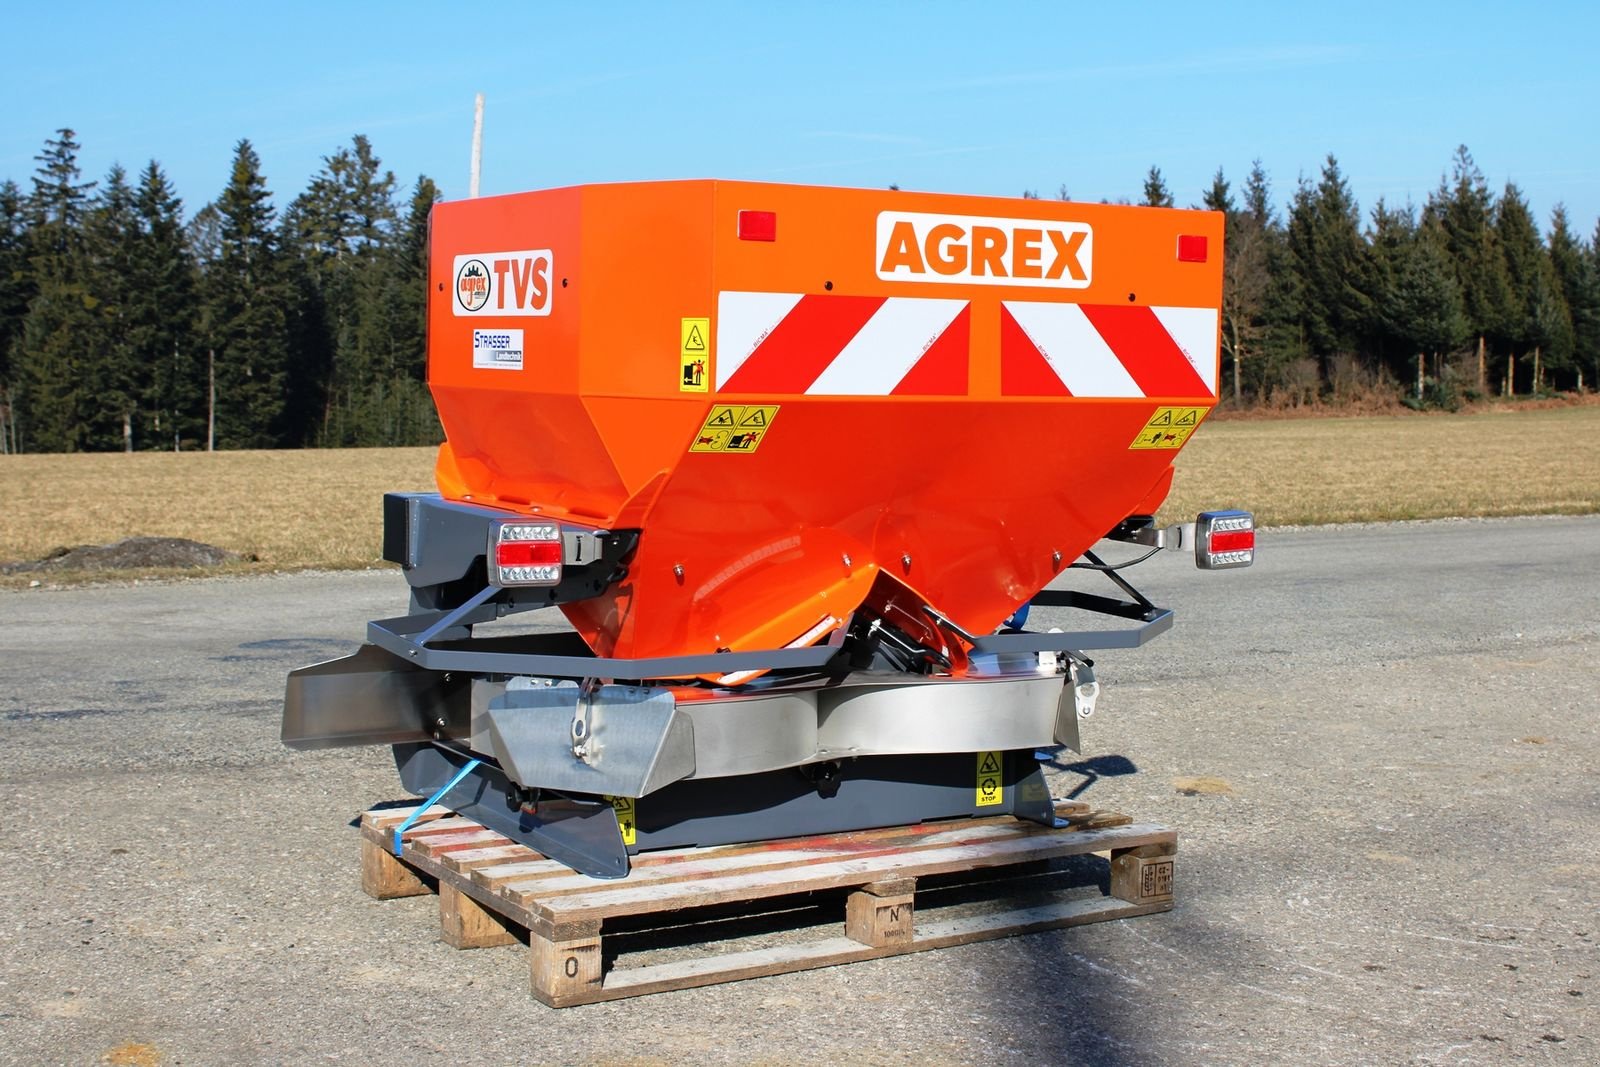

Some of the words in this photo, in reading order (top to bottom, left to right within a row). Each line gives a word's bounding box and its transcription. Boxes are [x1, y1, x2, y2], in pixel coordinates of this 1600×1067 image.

[880, 221, 1088, 281] AGREX
[460, 277, 486, 307] agrex
[494, 257, 548, 310] TVS
[890, 908, 899, 922] N
